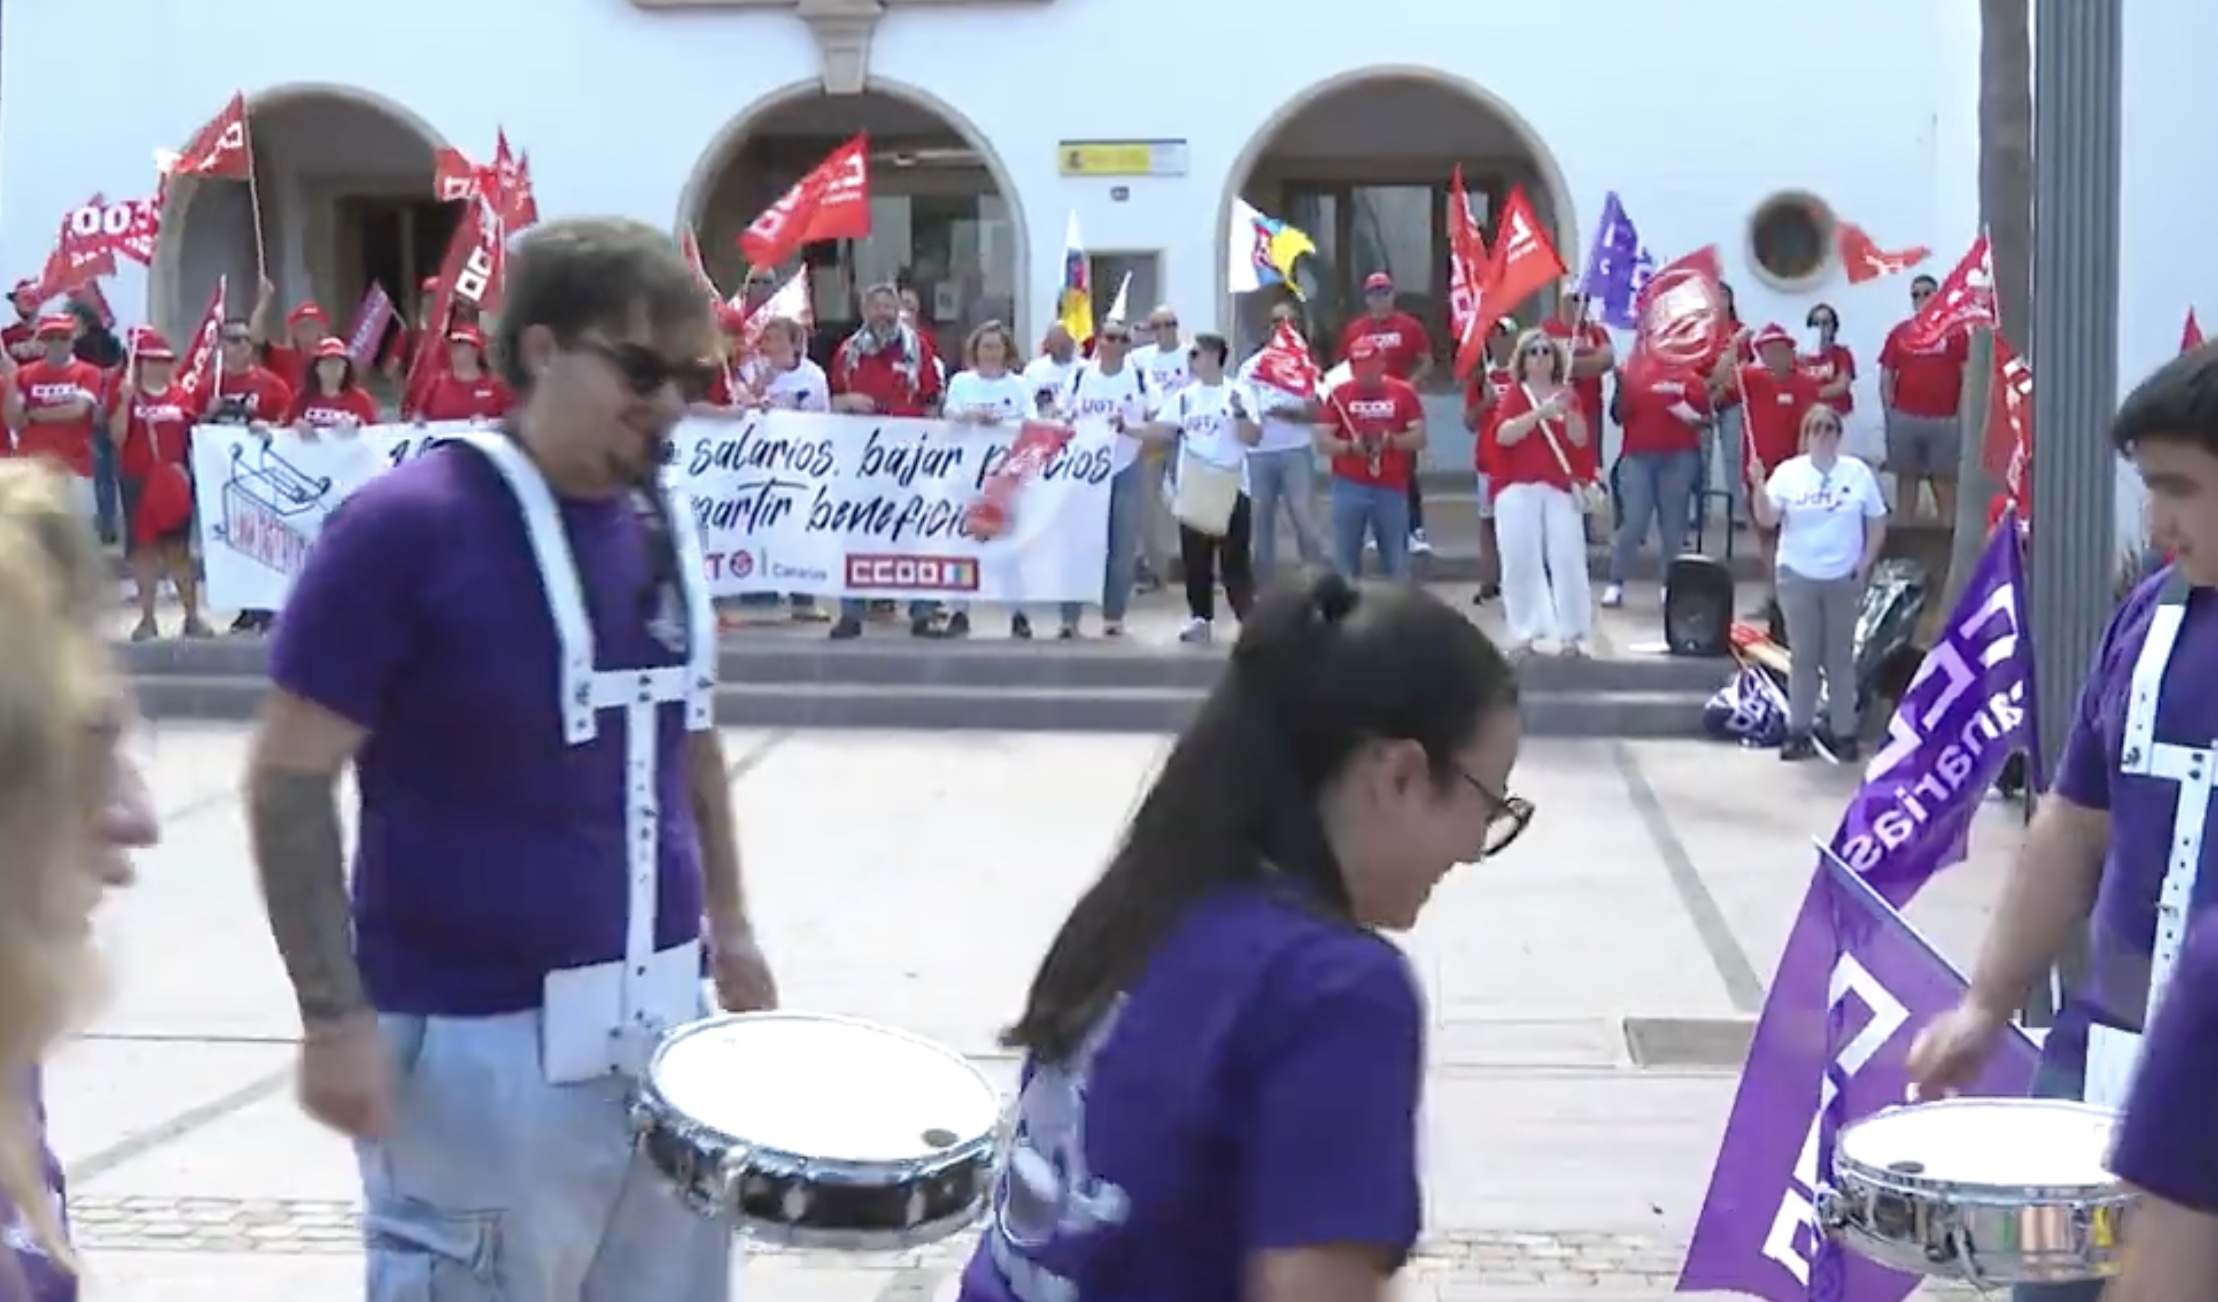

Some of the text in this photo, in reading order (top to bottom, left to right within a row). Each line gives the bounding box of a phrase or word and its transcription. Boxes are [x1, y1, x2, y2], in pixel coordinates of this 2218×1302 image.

[856, 427, 963, 487] bajar
[975, 444, 1112, 489] pcios
[805, 484, 989, 543] beneficio
[851, 559, 939, 584] CCOO
